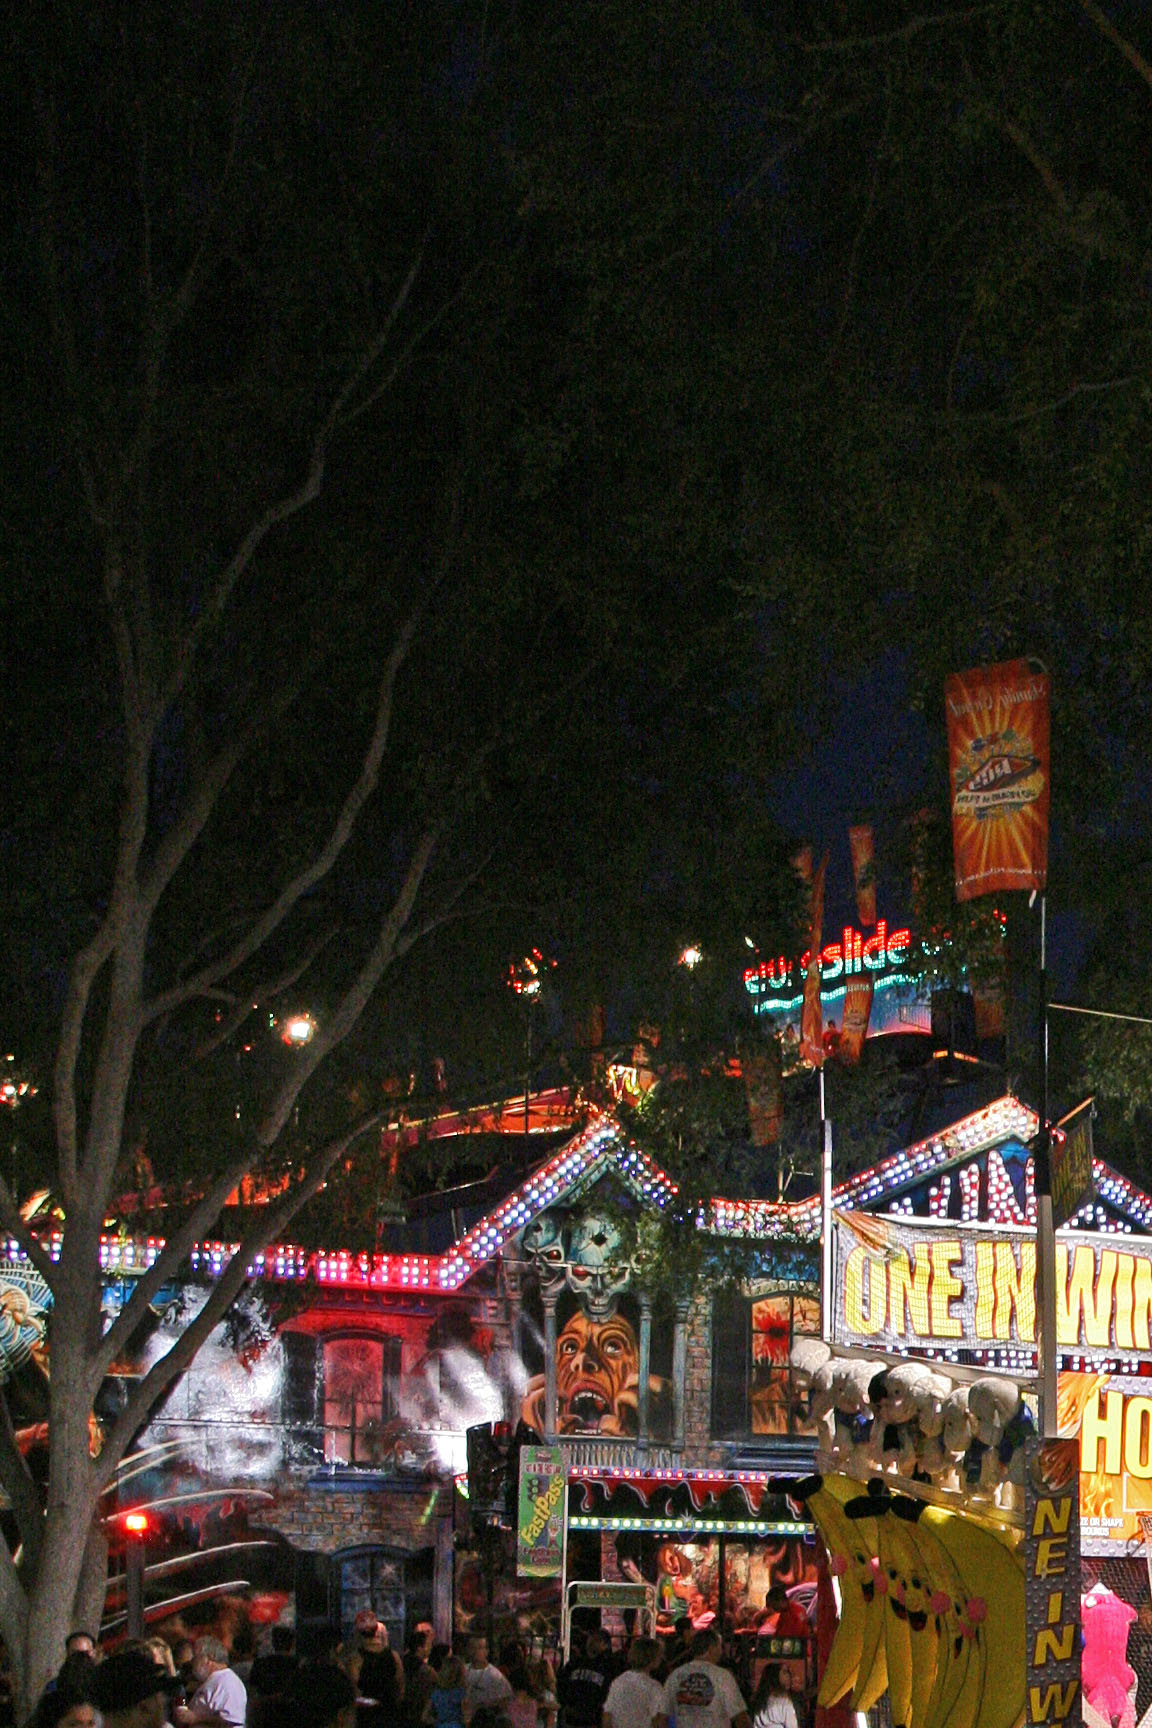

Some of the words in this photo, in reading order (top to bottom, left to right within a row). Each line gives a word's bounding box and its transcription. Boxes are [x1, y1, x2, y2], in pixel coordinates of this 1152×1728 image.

[844, 1240, 963, 1338] ONE
[975, 1241, 1037, 1342] IN
[520, 1475, 566, 1547] FastPass
[1101, 1517, 1124, 1528] SHAPE
